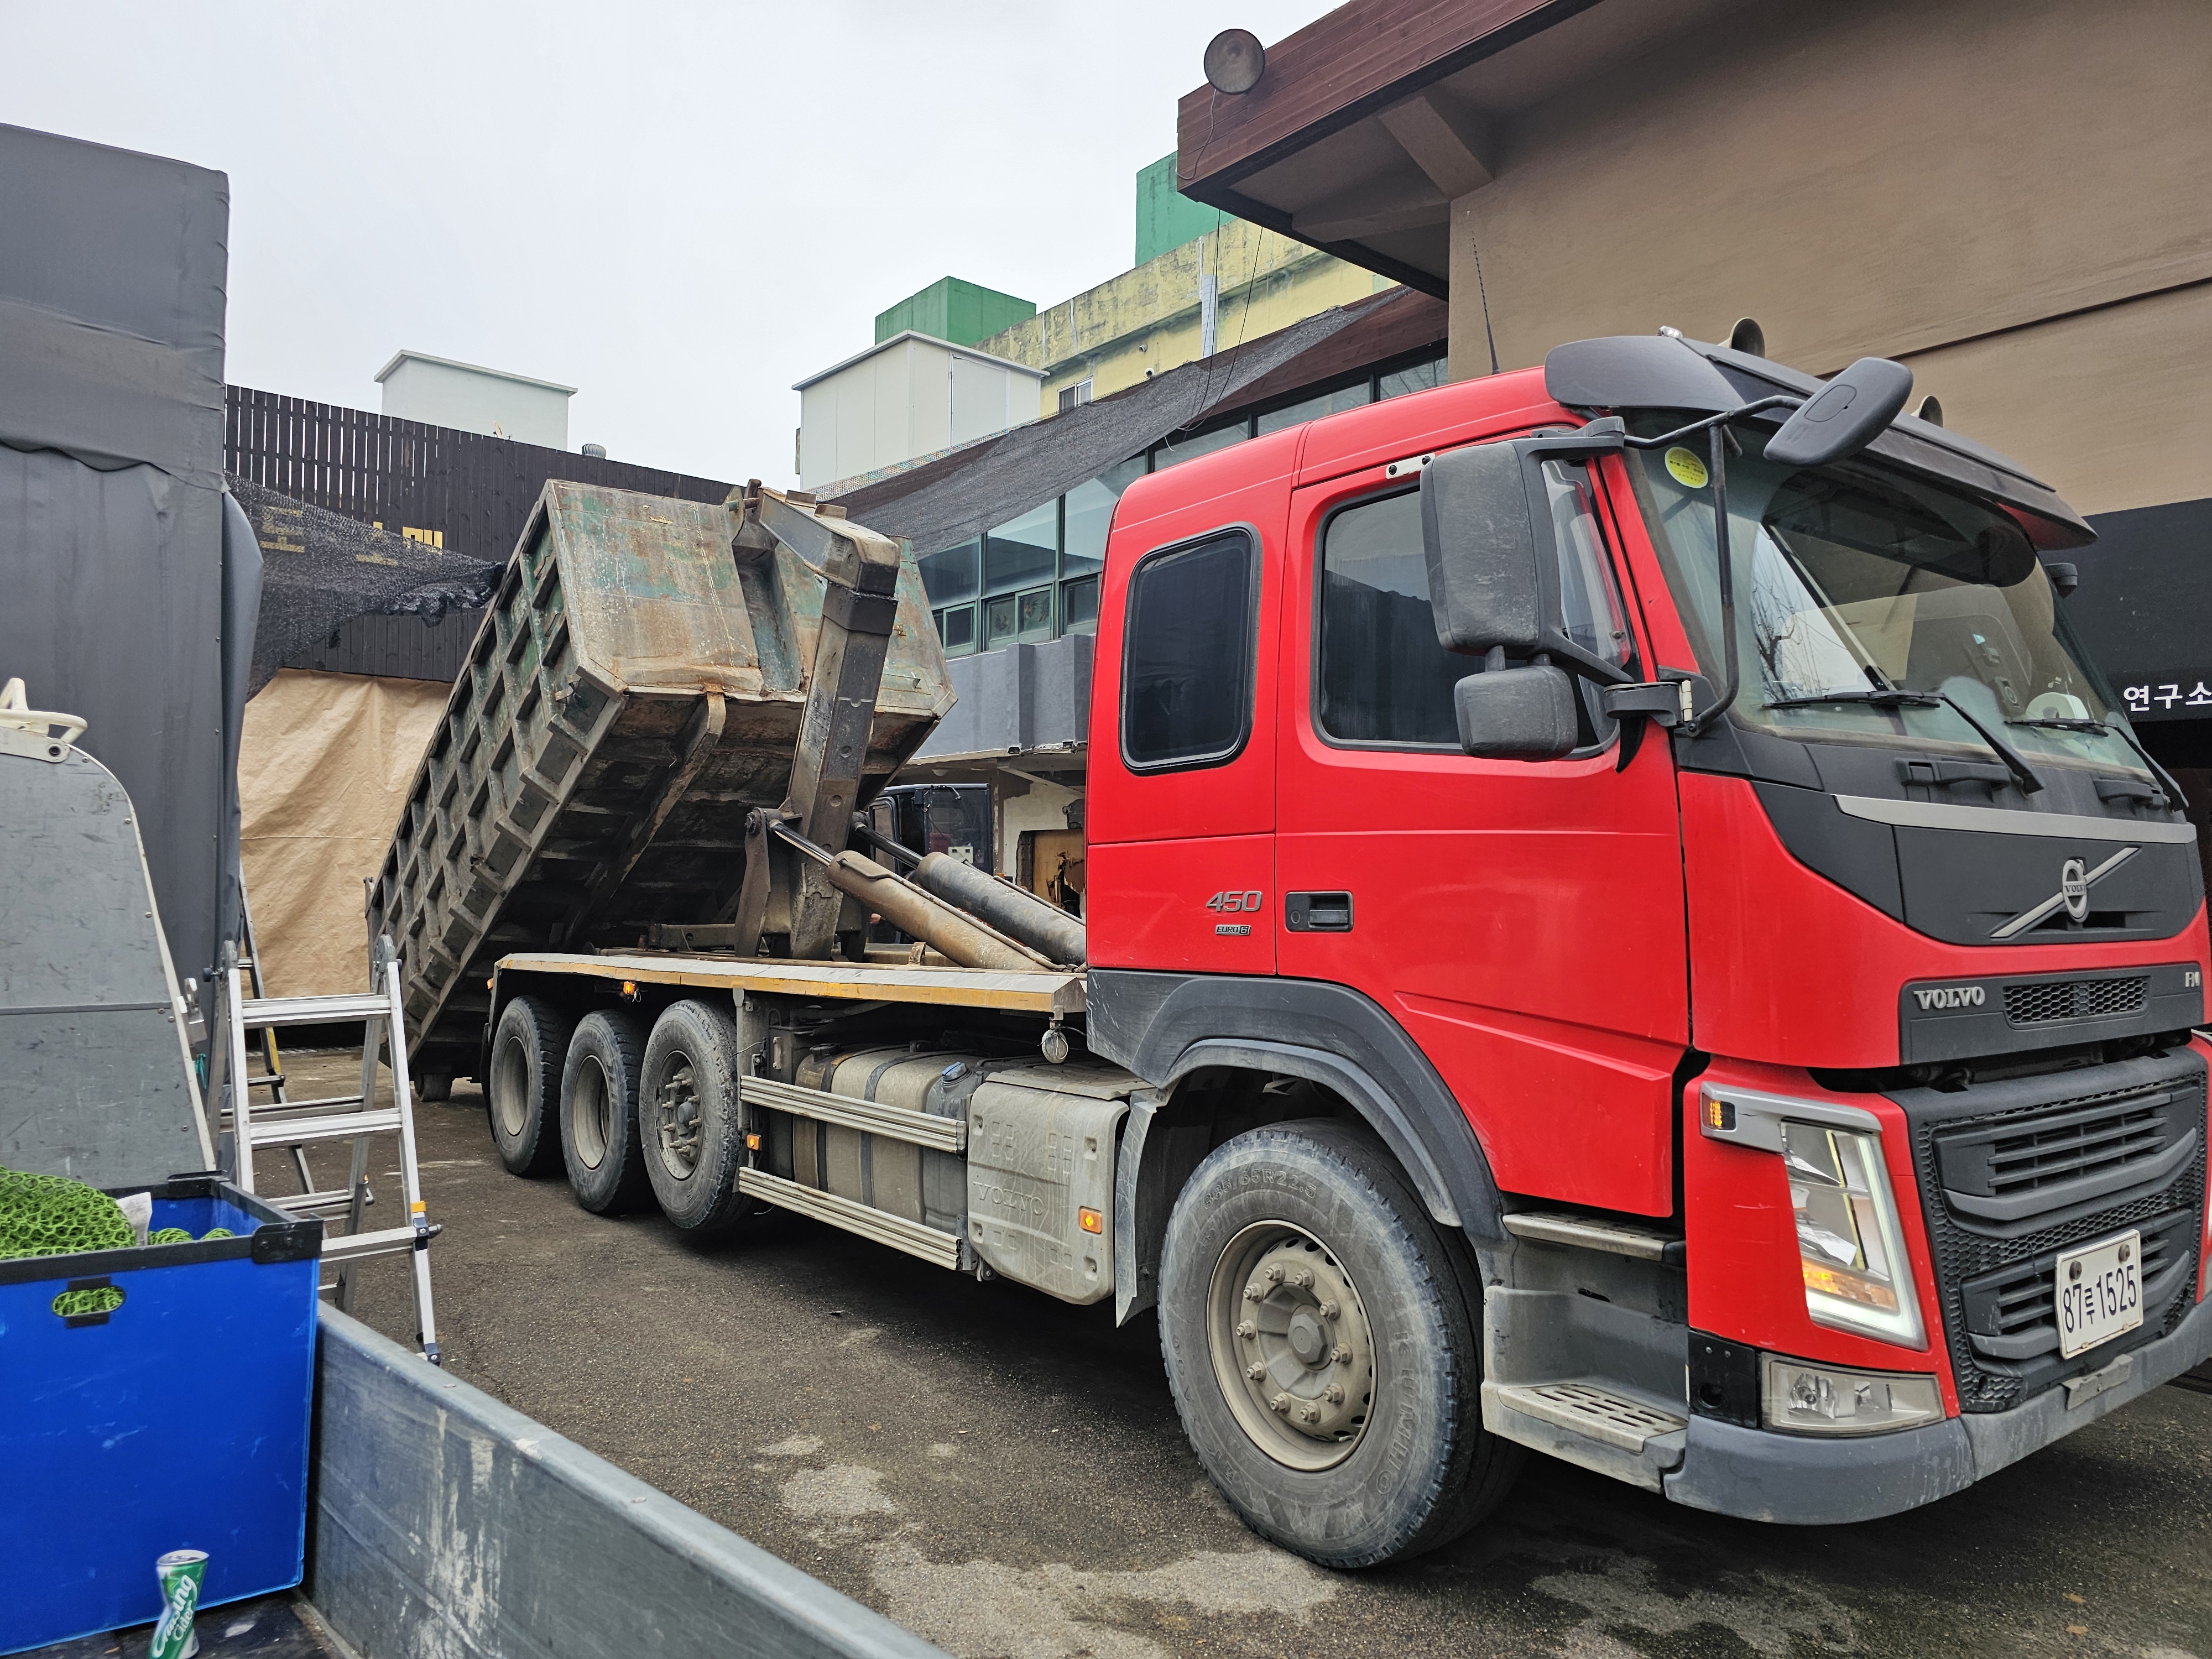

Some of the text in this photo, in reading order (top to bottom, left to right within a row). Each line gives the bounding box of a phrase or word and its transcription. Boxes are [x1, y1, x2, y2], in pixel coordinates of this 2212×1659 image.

[2124, 682, 2212, 712] 연구소
[1206, 891, 1262, 912] 450
[1914, 986, 1985, 1010] VOLVO
[973, 1181, 1044, 1215] VOLVO
[1203, 1168, 1317, 1209] 385/65R22.5
[2063, 1264, 2137, 1333] 87루1525
[1376, 1330, 1416, 1495] KUMHO
